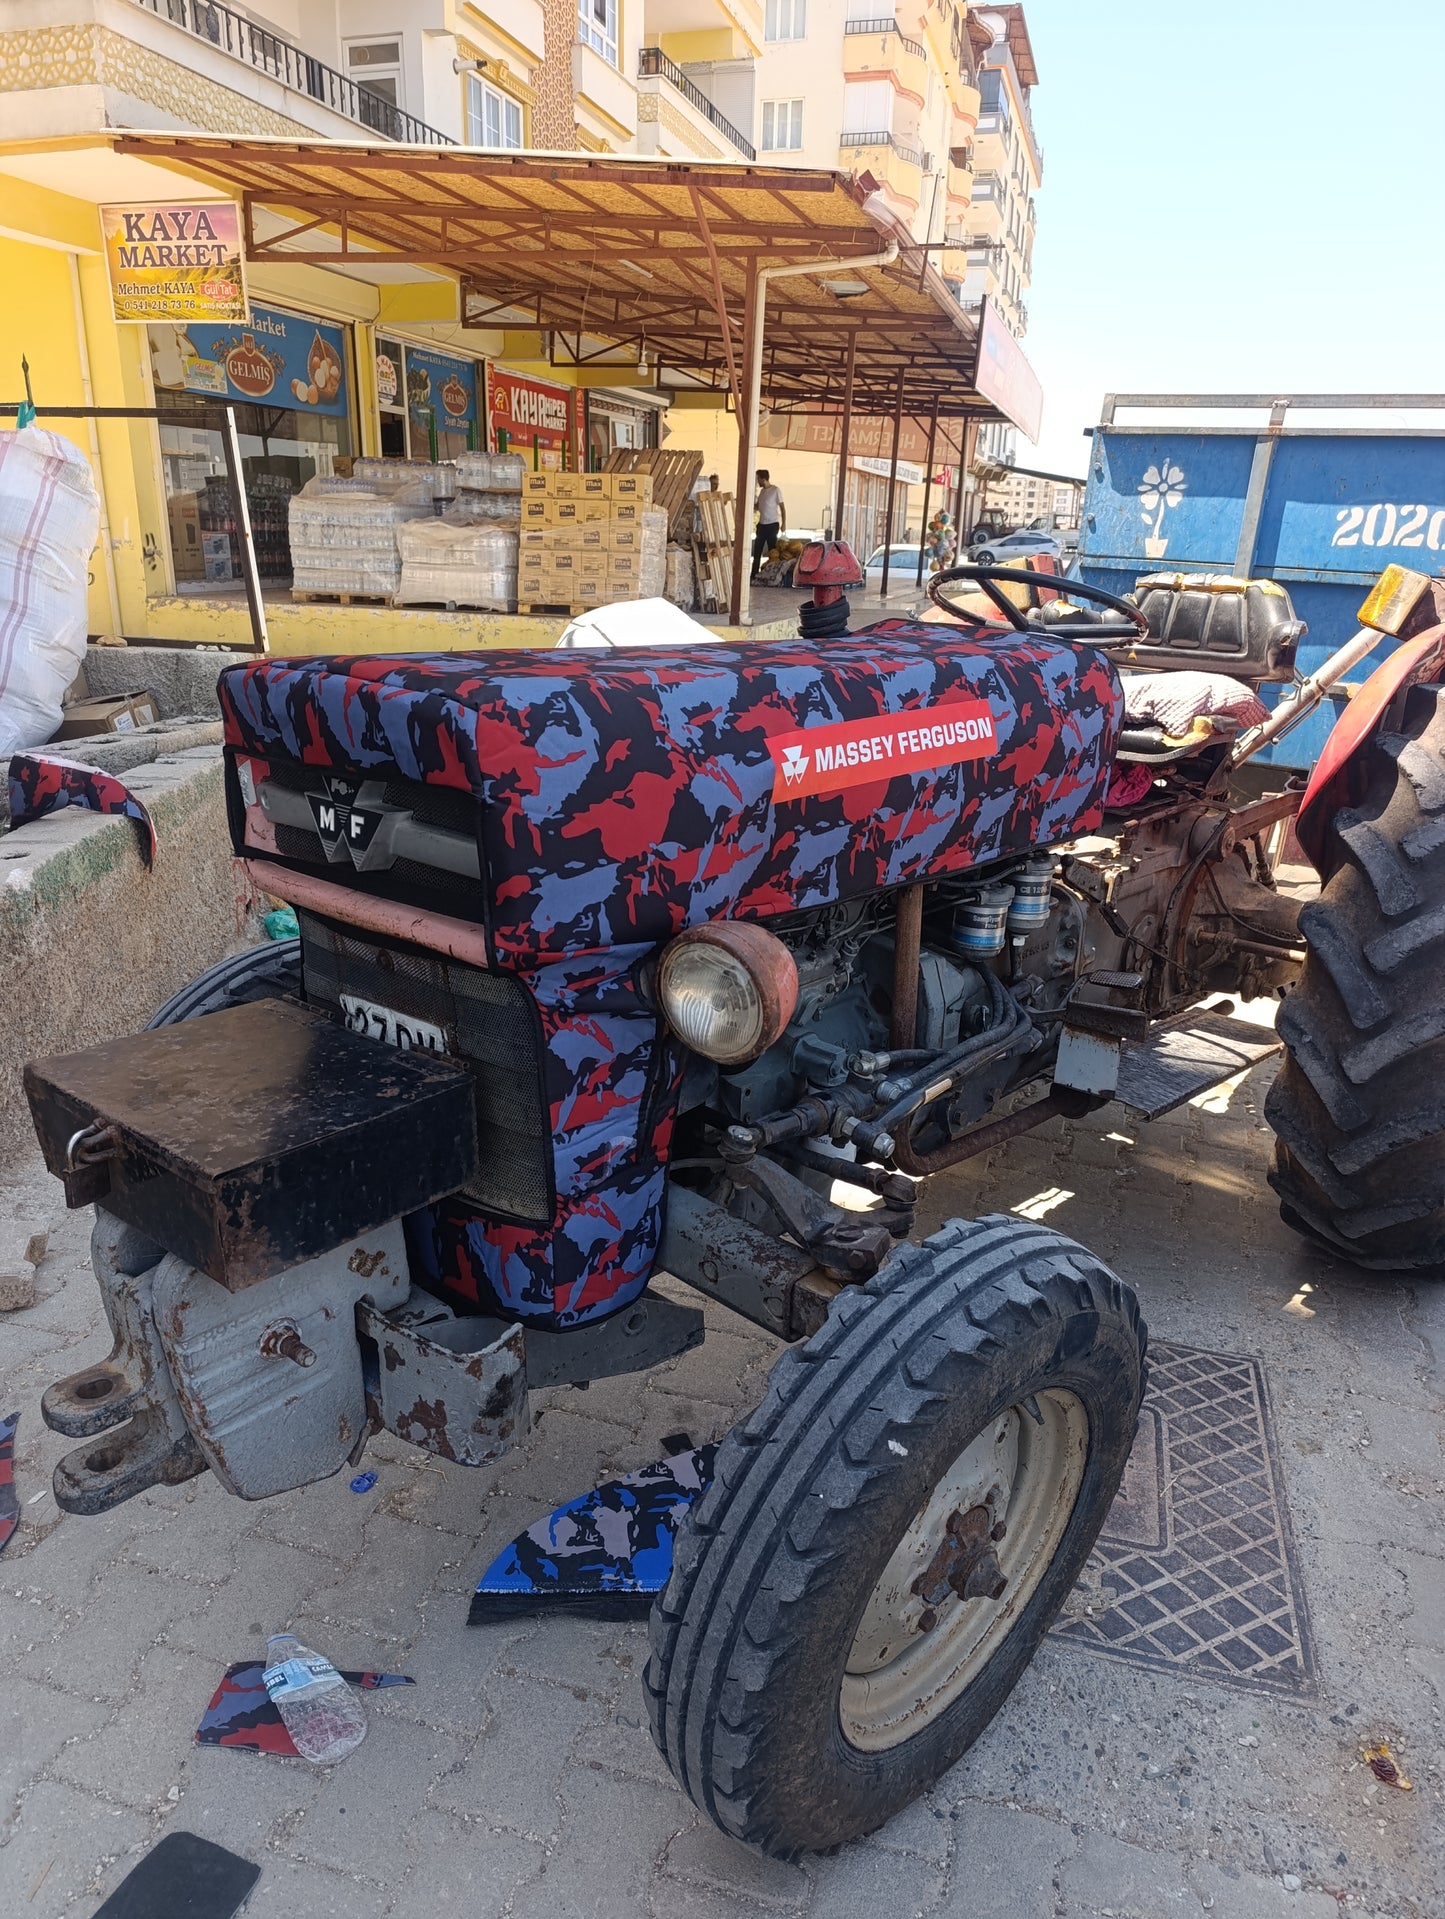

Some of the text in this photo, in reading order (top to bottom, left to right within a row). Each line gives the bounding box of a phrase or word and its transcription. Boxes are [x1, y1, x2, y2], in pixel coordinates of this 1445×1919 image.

[122, 211, 218, 242] KAYA
[118, 244, 228, 267] MARKET
[118, 282, 196, 295] Mehmet KAYA
[124, 300, 196, 310] 0 541 218 73 76
[229, 359, 271, 386] GELMİŞ
[511, 386, 546, 427] KAYA
[544, 417, 567, 431] MARKET
[815, 717, 993, 773] MASSEY FERGUSON
[320, 805, 365, 839] M F
